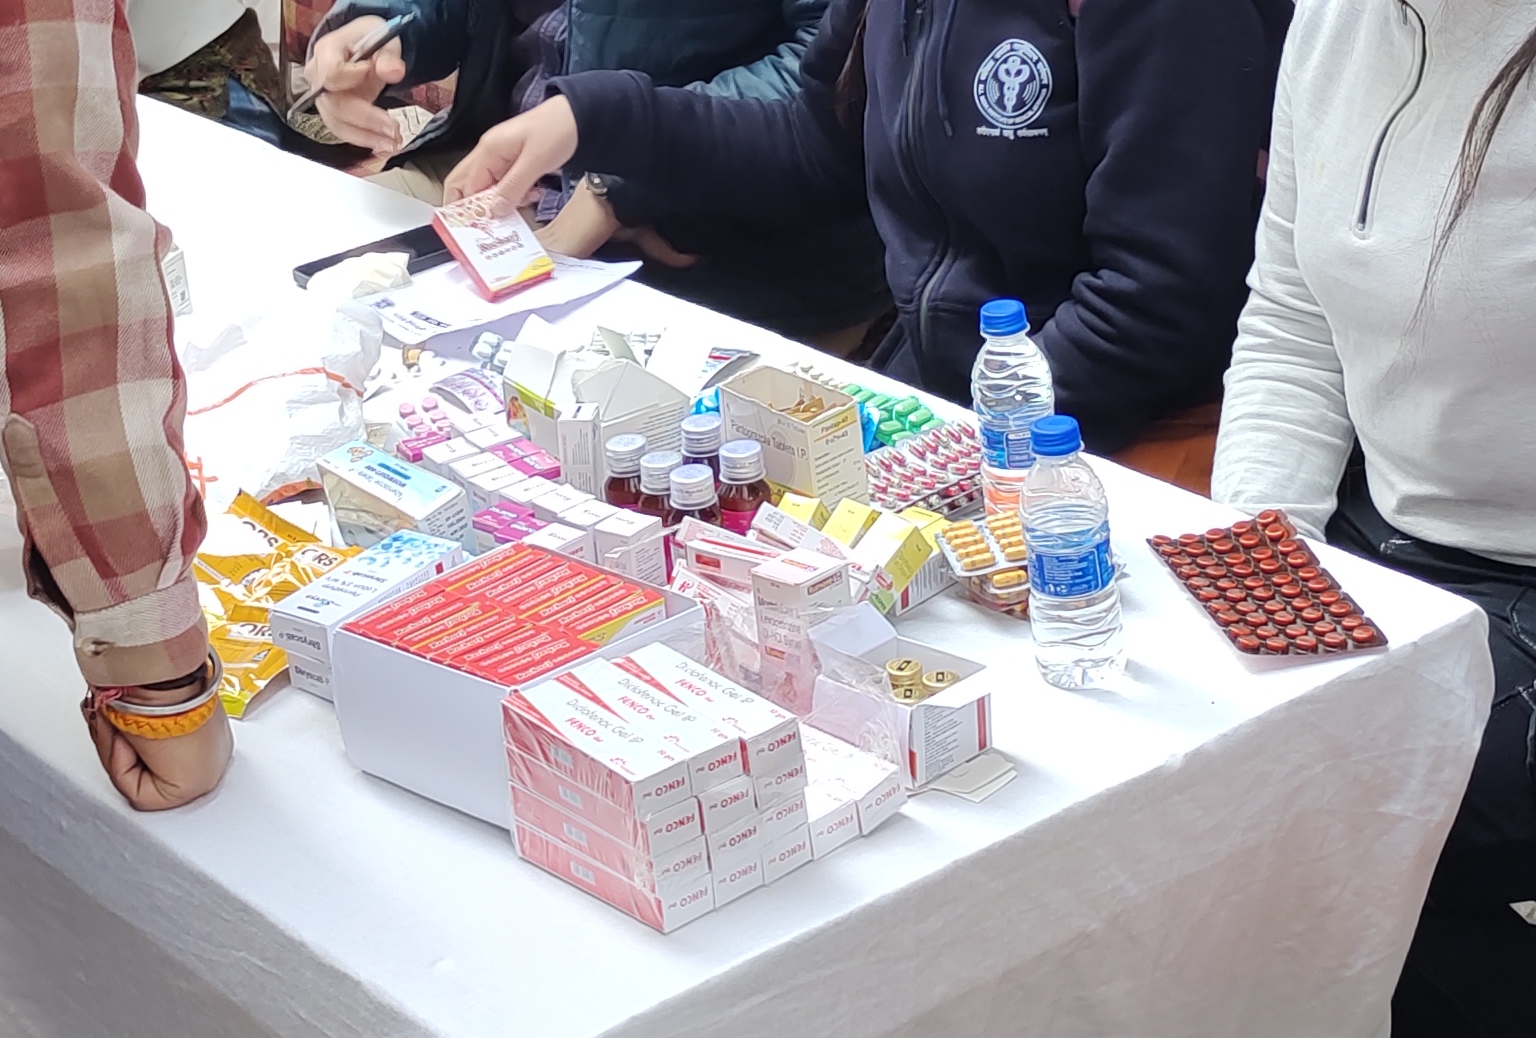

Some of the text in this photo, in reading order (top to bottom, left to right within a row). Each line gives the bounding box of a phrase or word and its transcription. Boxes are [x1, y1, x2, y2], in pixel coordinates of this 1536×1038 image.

[675, 661, 722, 690] Diclofenac
[721, 686, 739, 700] Gel
[675, 678, 706, 697] FENCO
[617, 677, 664, 708] Diclofenac
[664, 705, 680, 718] Gel
[617, 696, 647, 714] FENCO
[565, 717, 594, 736] FENCO
[566, 698, 613, 729] Diclofenac
[611, 725, 628, 739] Gel
[767, 731, 797, 752] FENCO
[707, 751, 738, 772] FENCO
[775, 765, 803, 786] FENCO
[655, 777, 686, 797] FENCO
[720, 788, 750, 809] FENCO
[775, 799, 803, 821] FENCO
[665, 812, 696, 833] FENCO
[826, 814, 854, 836] FENCO
[729, 826, 758, 847] FENCO
[779, 840, 806, 862] FENCO
[672, 852, 703, 873] FENCO
[729, 862, 758, 883] FENCO
[679, 886, 709, 907] FENCO
